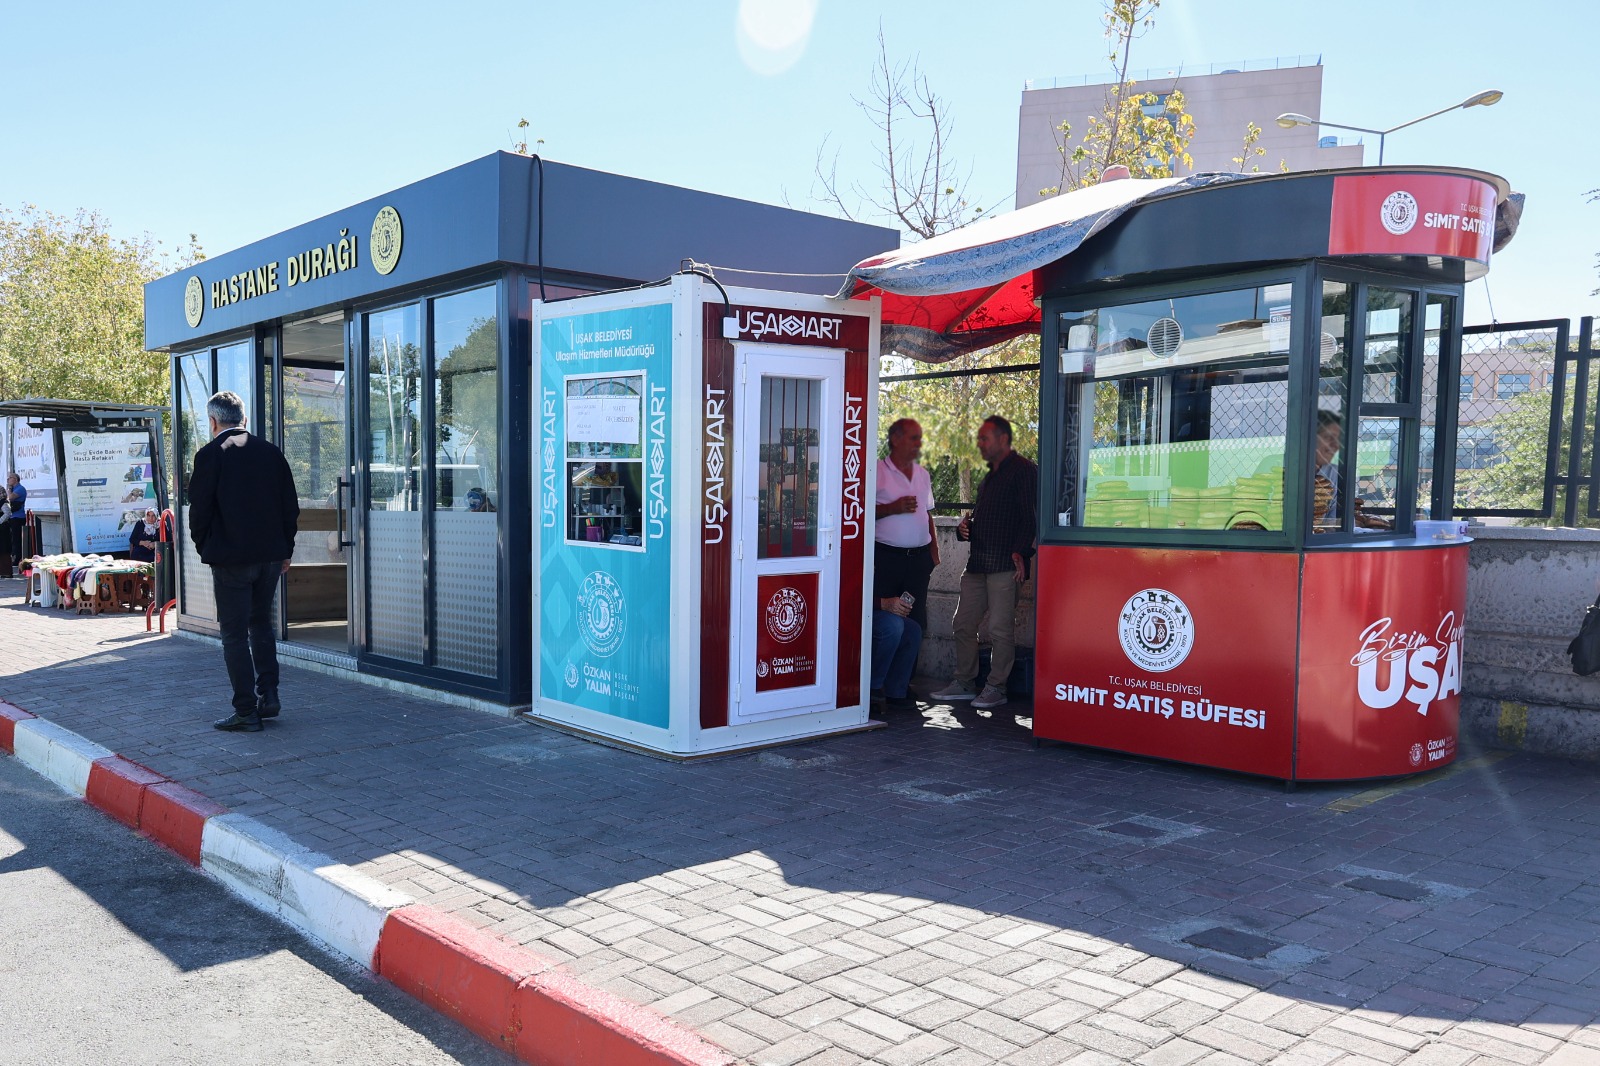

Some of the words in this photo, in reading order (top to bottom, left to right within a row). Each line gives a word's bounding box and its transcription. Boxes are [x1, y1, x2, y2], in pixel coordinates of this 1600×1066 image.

[1462, 217, 1486, 237] SATIŞ
[212, 261, 279, 309] HASTANE
[287, 228, 358, 287] DURAĞI
[575, 332, 593, 346] UŞAK
[594, 326, 633, 343] BELEDİYESİ
[555, 350, 577, 364] Ulaşım
[578, 347, 613, 361] Hizmetleri
[614, 343, 655, 359] Müdürlüğü
[1146, 607, 1175, 632] BELEDİYESİ
[1350, 617, 1430, 667] Bizim
[583, 662, 611, 681] ÖZKAN
[772, 657, 794, 667] ÖZKAN
[773, 665, 794, 675] YALIM
[584, 679, 611, 697] YALIM
[1109, 675, 1123, 687] T.C.
[1124, 677, 1148, 689] UŞAK
[1150, 680, 1202, 696] BELEDİYESİ
[1357, 641, 1464, 717] UŞA
[1113, 691, 1175, 720] SATIŞ
[1181, 698, 1266, 730] BÜFESİ
[1427, 738, 1446, 751] ÖZKAN
[1428, 749, 1445, 762] YALIM
